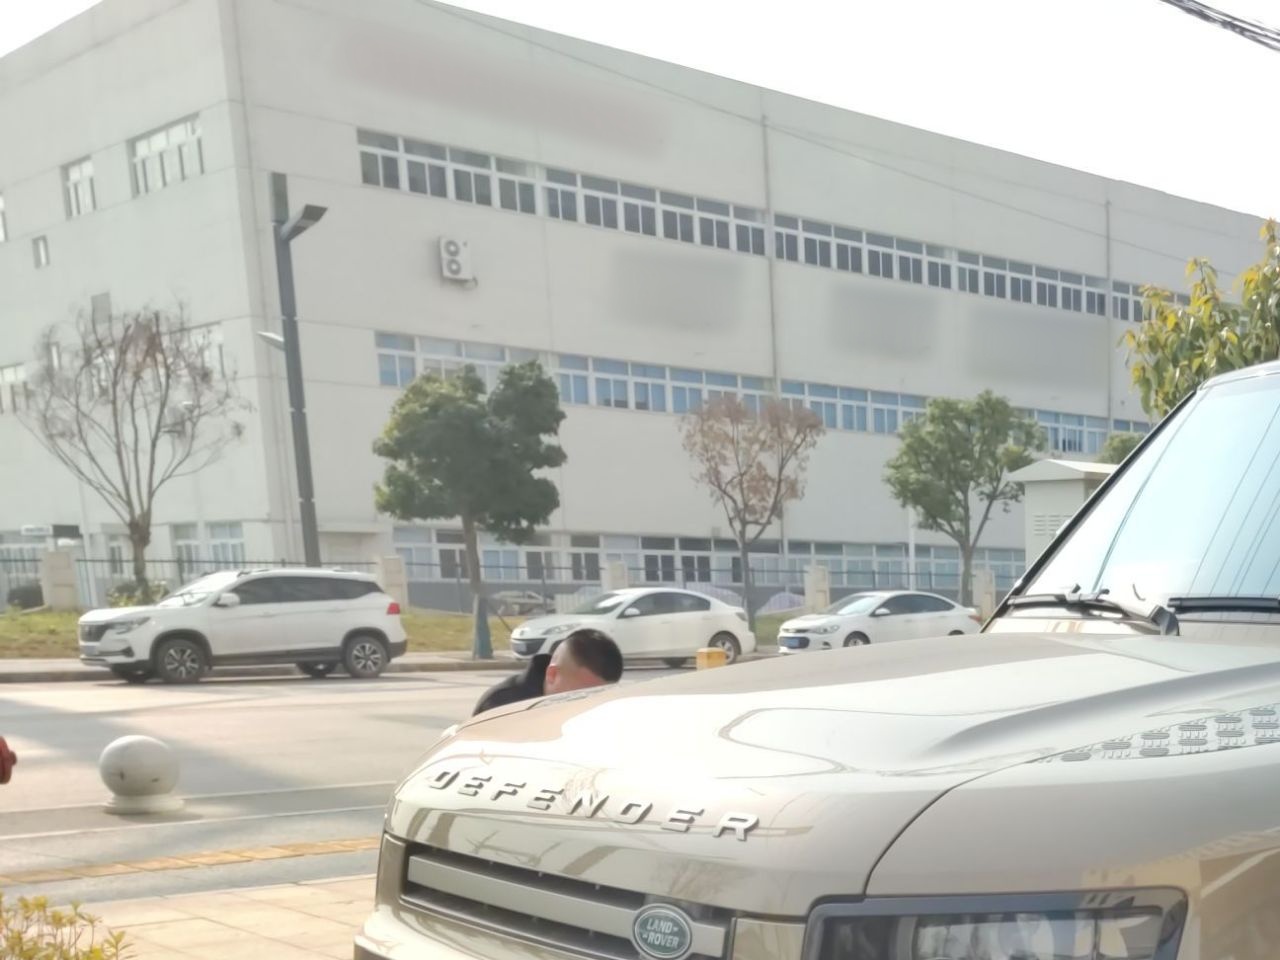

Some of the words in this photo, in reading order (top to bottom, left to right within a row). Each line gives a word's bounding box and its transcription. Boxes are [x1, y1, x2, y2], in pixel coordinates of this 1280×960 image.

[428, 771, 760, 842] DEFENDER
[646, 918, 673, 934] LAND
[647, 931, 680, 949] ROVER
